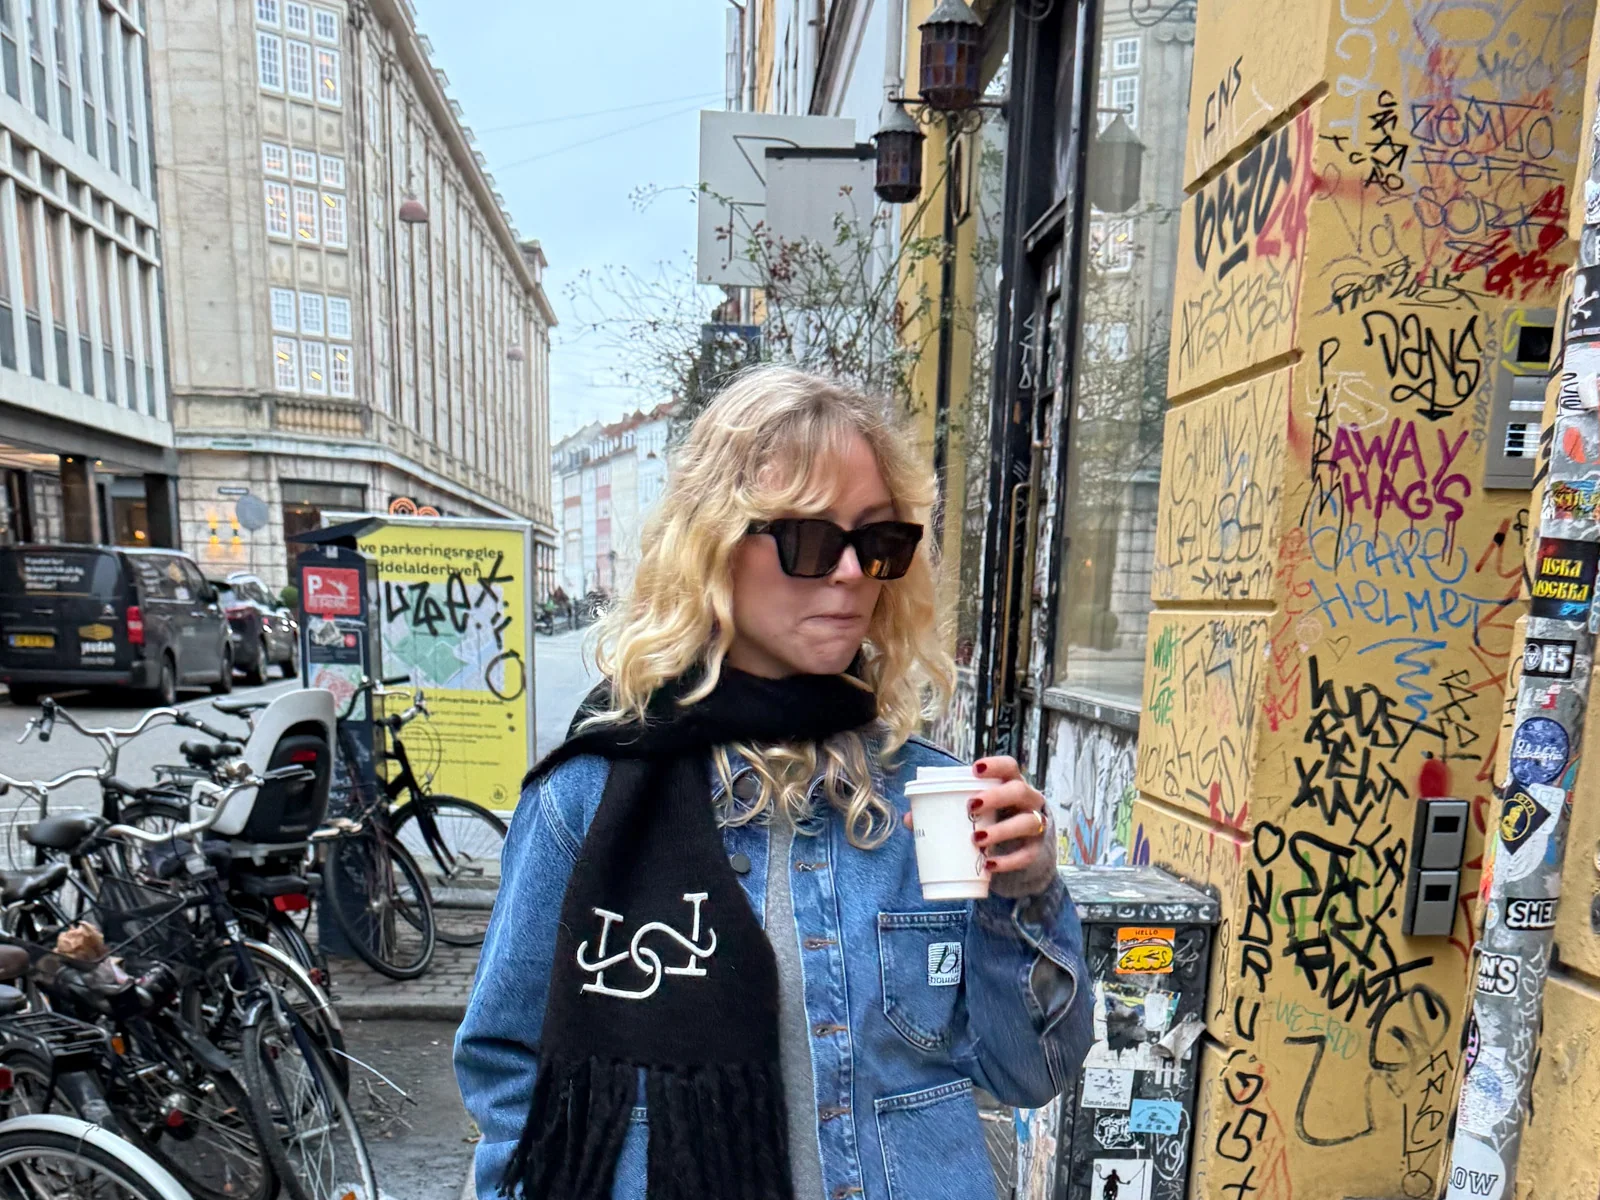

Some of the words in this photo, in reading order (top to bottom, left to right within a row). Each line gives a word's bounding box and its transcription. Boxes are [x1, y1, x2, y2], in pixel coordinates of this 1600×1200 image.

[1328, 417, 1470, 487] AWAY
[377, 561, 482, 578] ddelalderbyen
[307, 574, 323, 595] P
[1449, 1166, 1499, 1196] OW
